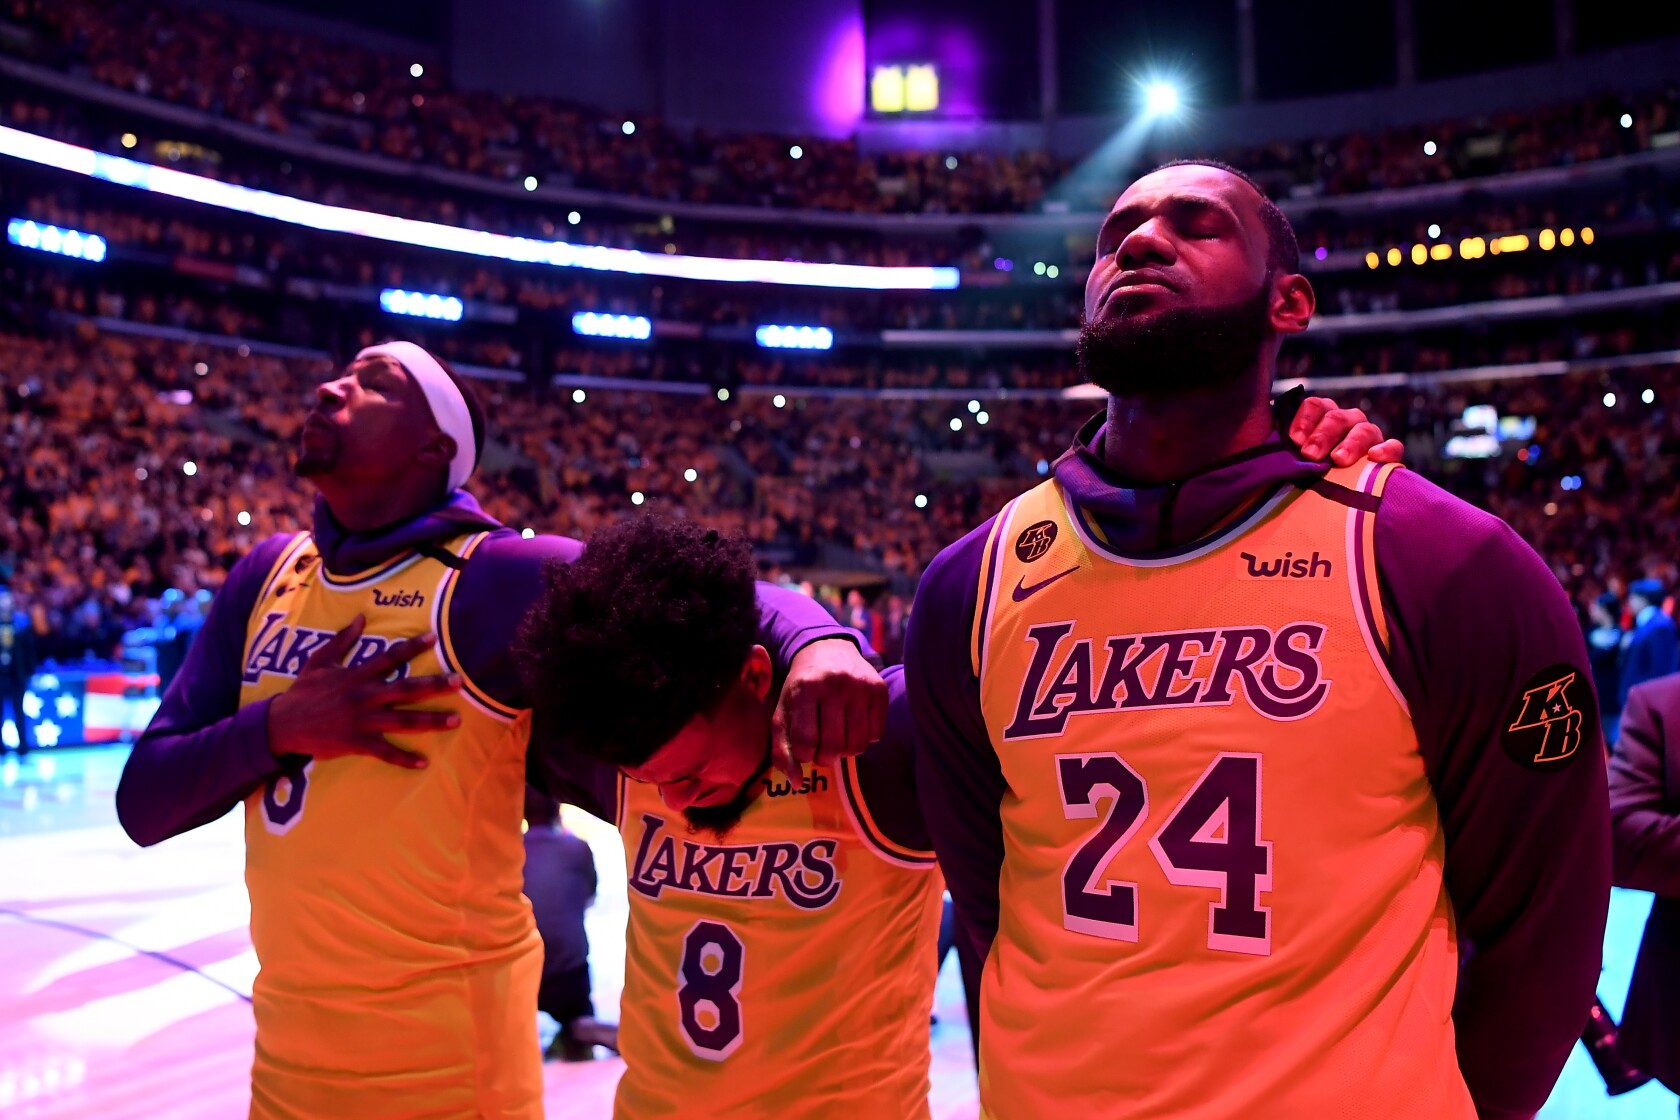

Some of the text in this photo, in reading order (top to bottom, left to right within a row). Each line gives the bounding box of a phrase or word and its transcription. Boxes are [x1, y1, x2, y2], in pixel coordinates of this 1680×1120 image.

[372, 588, 425, 608] wish
[1240, 551, 1332, 579] wish
[1002, 620, 1332, 743] LAKERS
[1508, 672, 1582, 762] KB
[761, 769, 828, 798] wsh
[628, 811, 843, 911] LAKERS
[1055, 751, 1274, 957] 24
[676, 918, 745, 1062] 8
